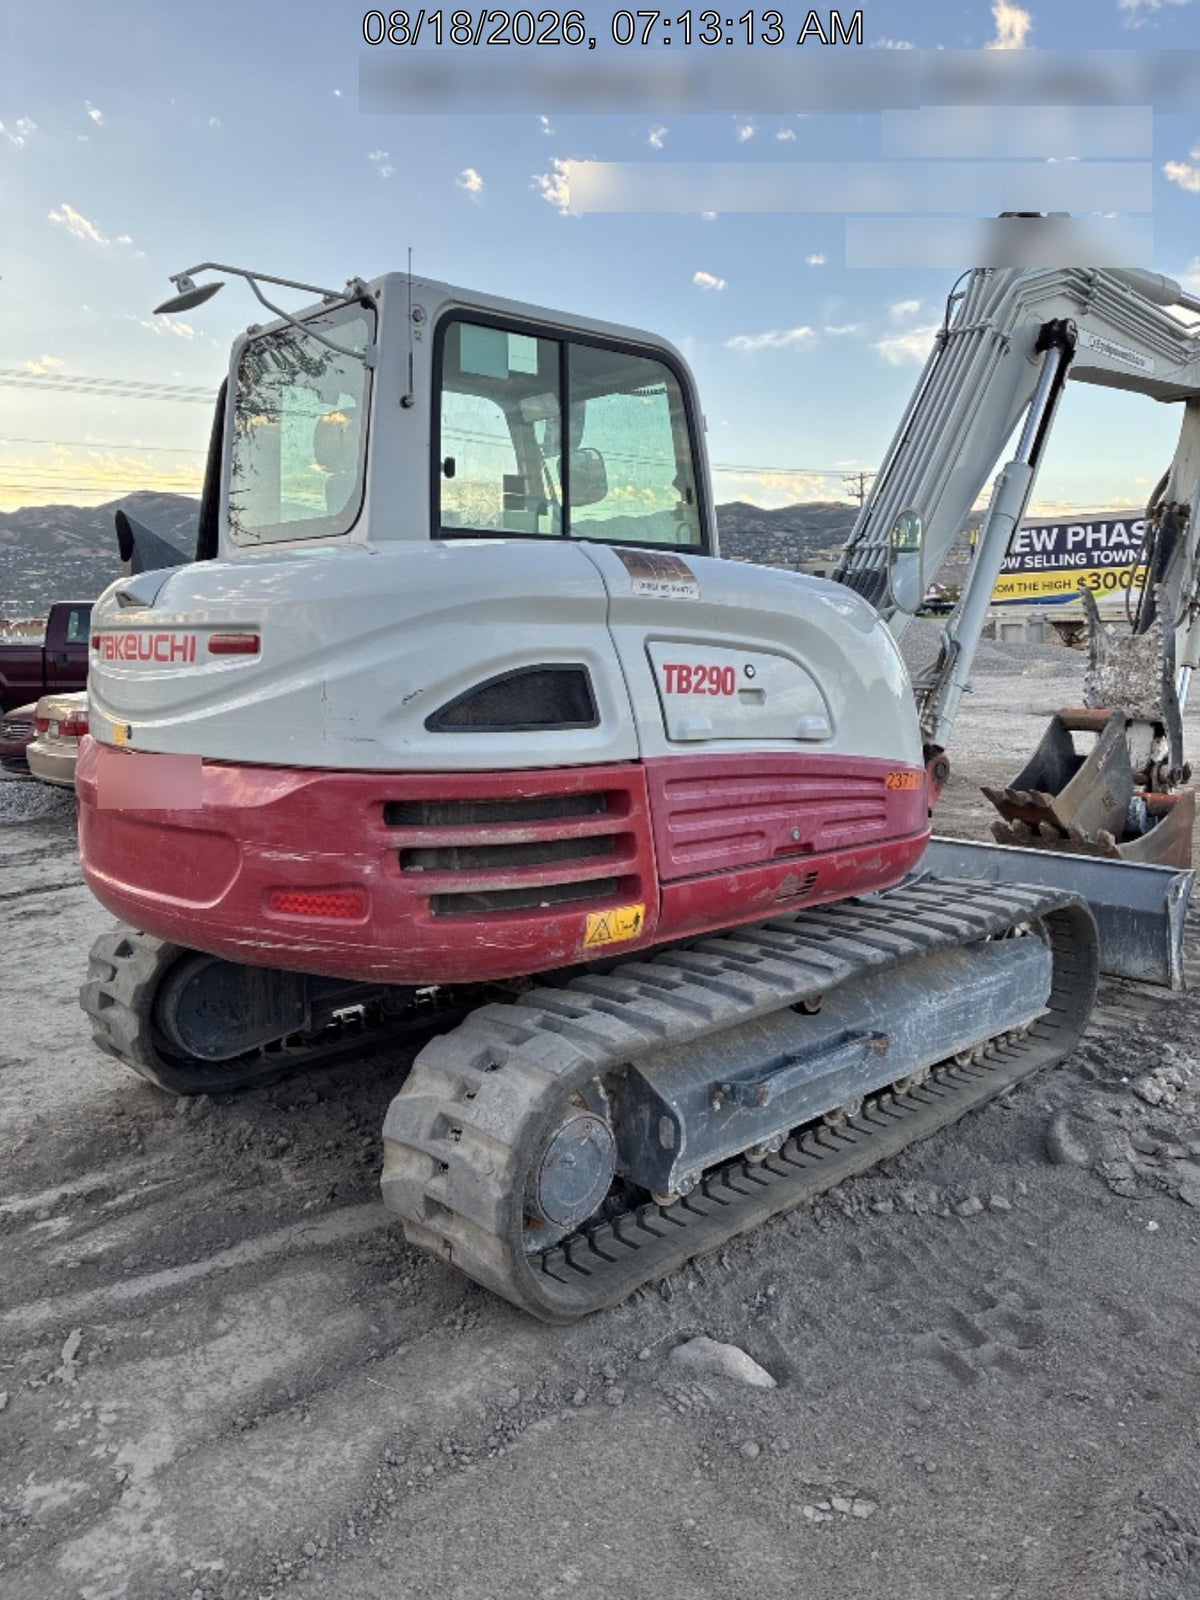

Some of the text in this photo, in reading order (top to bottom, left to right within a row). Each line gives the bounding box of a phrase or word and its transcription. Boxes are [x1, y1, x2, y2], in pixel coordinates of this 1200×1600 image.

[1014, 520, 1145, 552] EW PHAS
[1024, 551, 1087, 568] SELLING
[1091, 548, 1147, 564] TOWN
[1017, 582, 1039, 592] THE
[1041, 579, 1071, 591] HIGH
[663, 664, 735, 696] TB290
